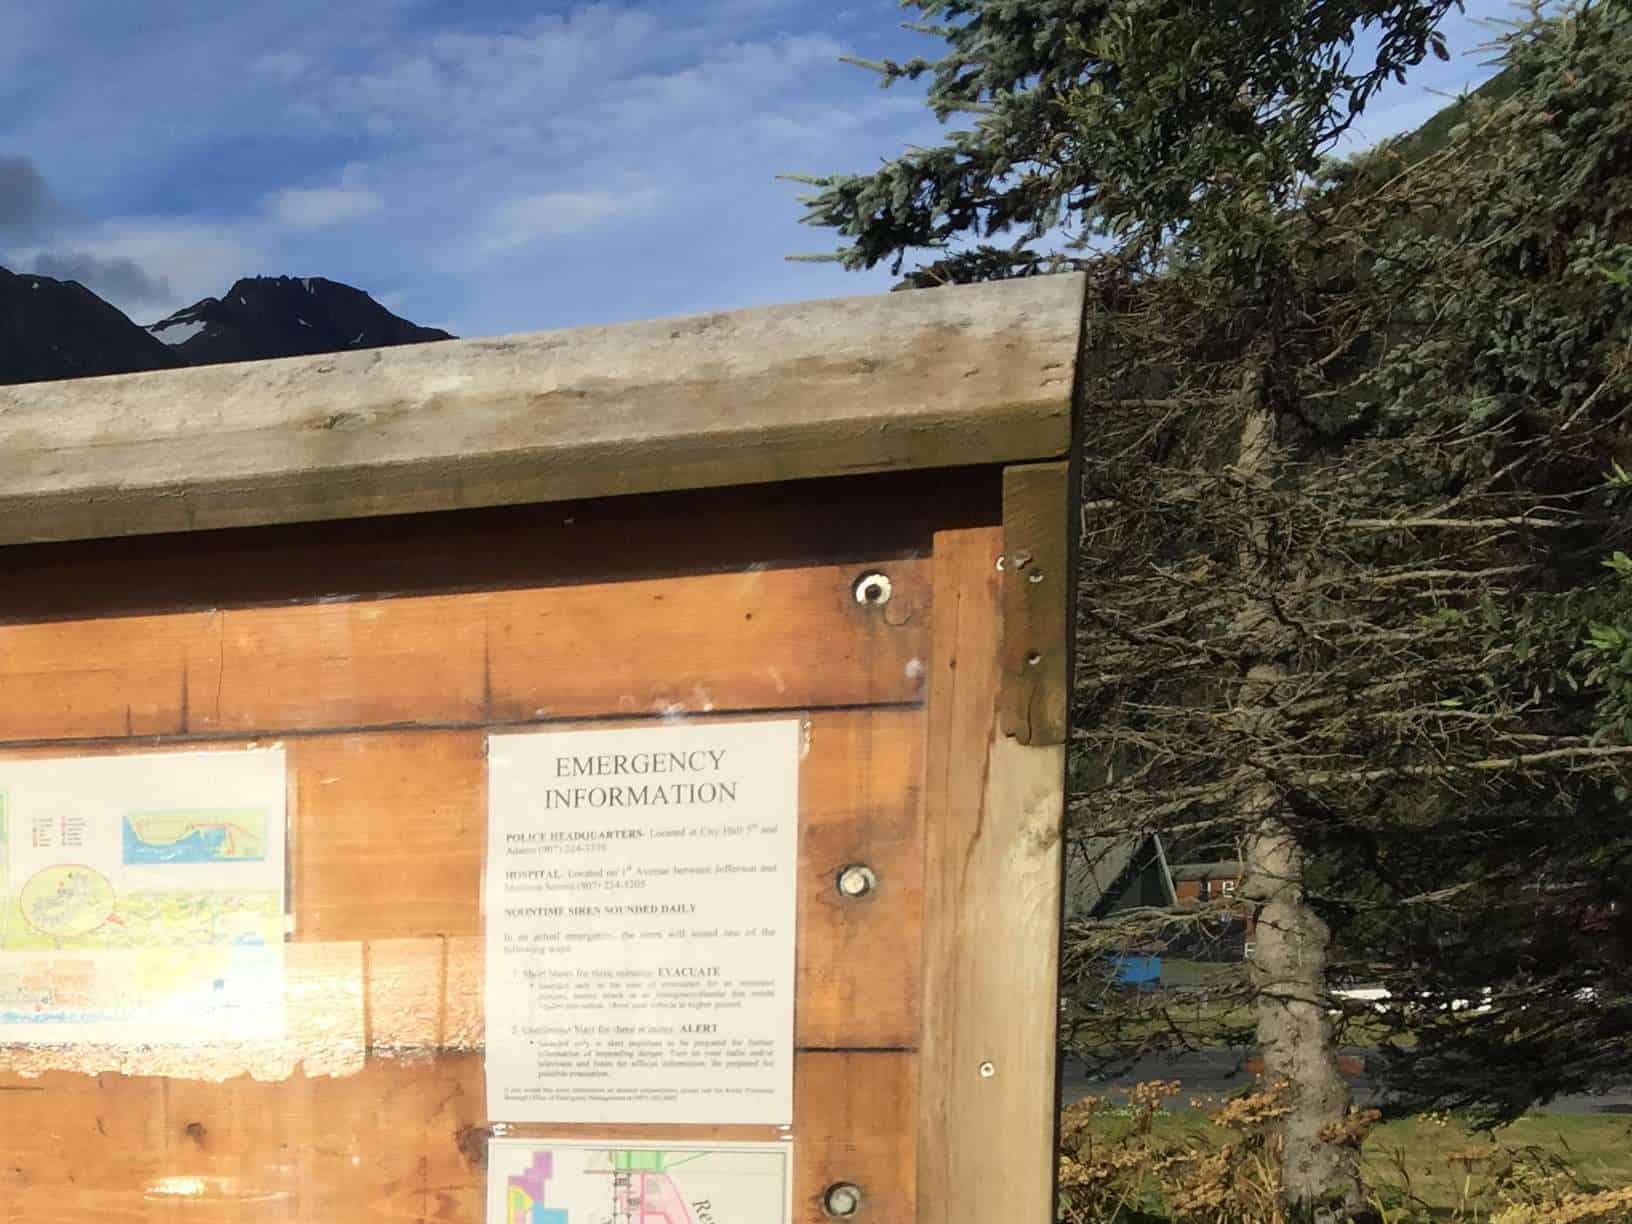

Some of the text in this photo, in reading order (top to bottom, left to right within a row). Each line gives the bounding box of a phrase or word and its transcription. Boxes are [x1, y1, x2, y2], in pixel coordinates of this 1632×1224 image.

[556, 749, 728, 778] EMERGENCY
[544, 781, 738, 810] INFORMATION
[506, 831, 546, 842] POLICE
[660, 903, 697, 914] DAILY
[657, 966, 721, 978] EVACUATE
[679, 1023, 720, 1034] ALERT
